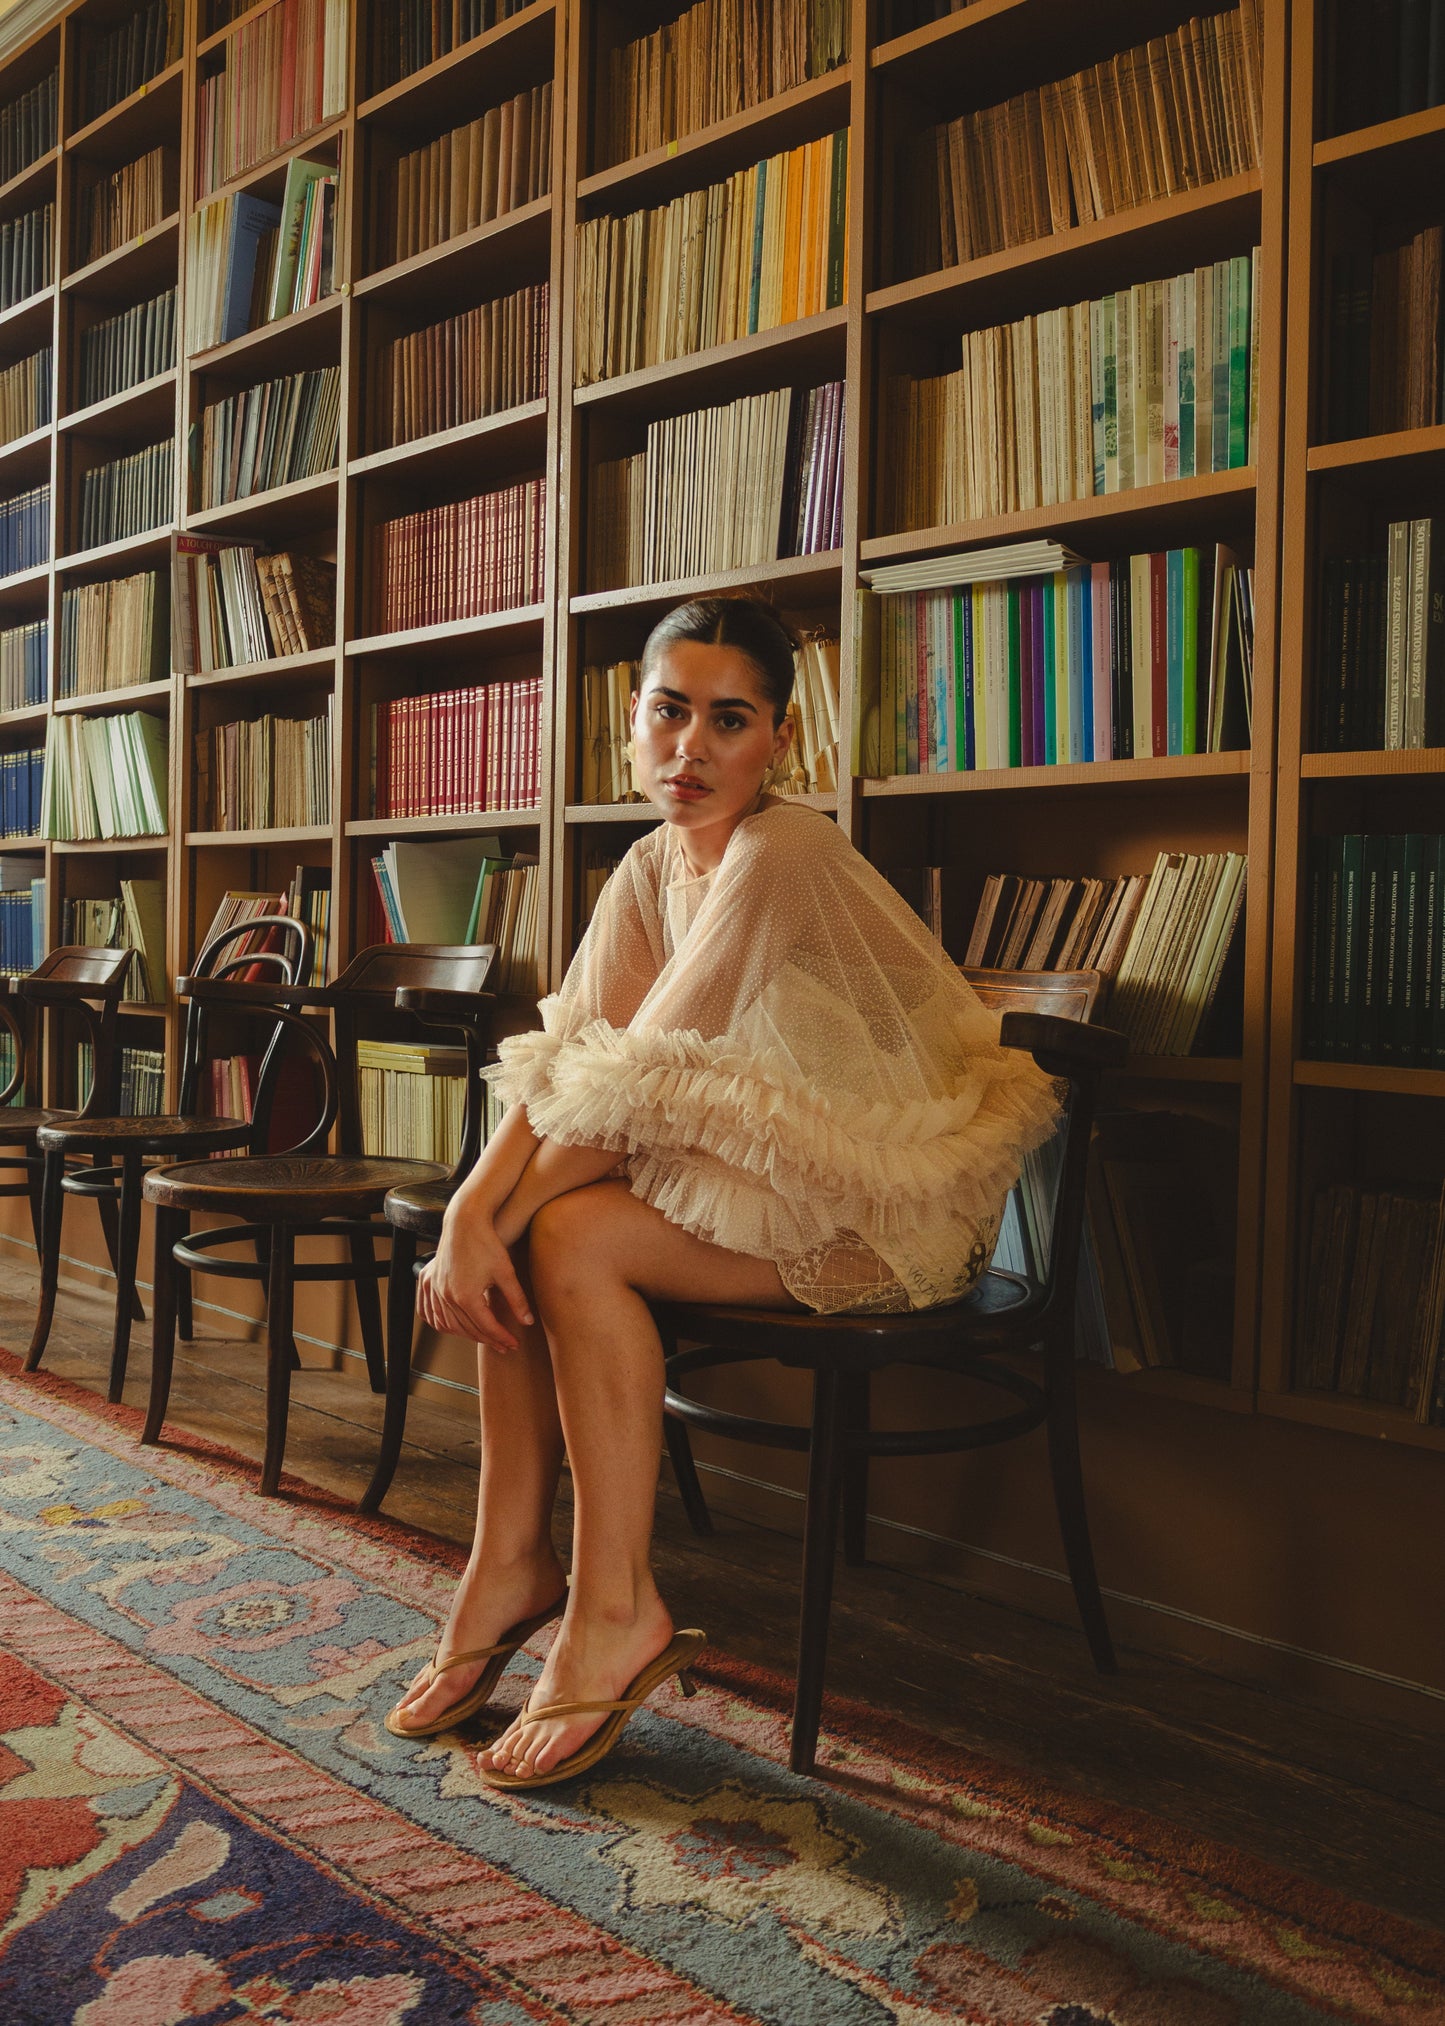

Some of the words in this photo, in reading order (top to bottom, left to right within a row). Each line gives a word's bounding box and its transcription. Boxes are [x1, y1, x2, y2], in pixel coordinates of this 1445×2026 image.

[1414, 526, 1425, 591] SOUTHWARK
[1391, 612, 1401, 679] EXCAVATIONS
[1412, 593, 1422, 660] EXCAVATIONS
[1389, 681, 1399, 746] SOUTHWARK
